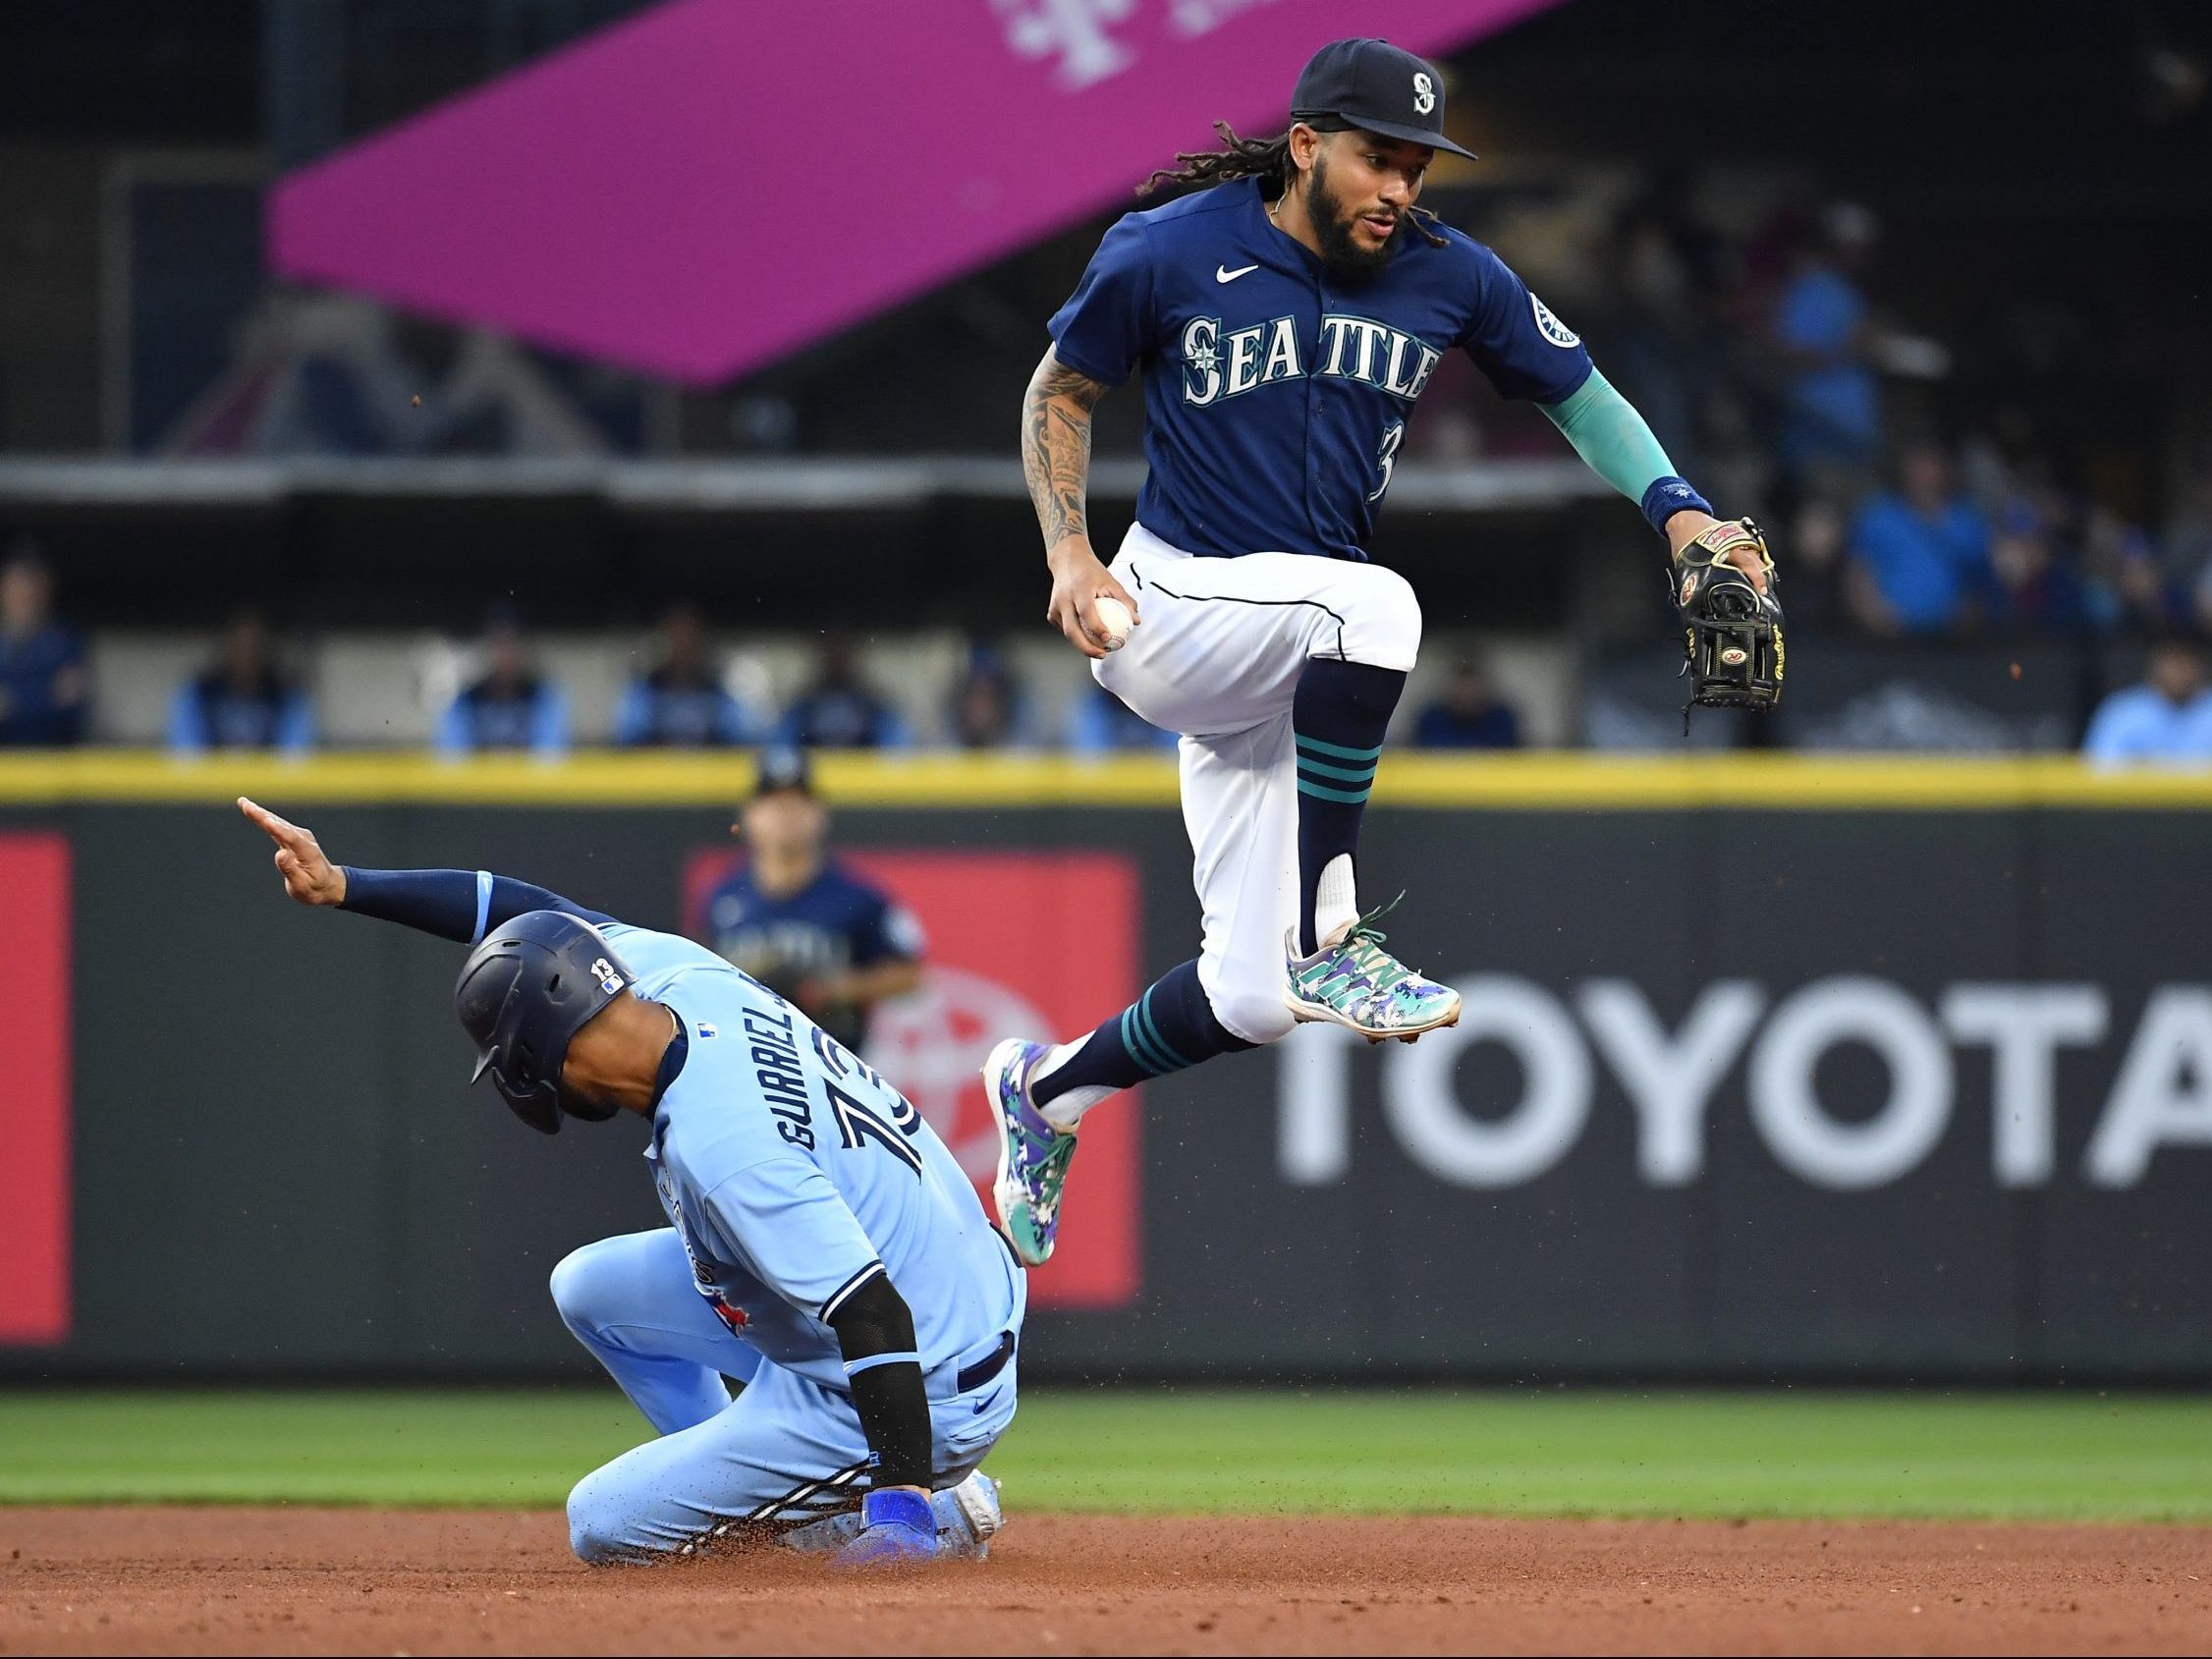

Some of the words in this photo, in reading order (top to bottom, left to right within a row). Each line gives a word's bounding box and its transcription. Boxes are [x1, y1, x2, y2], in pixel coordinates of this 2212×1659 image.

[1413, 73, 1436, 115] S
[1181, 314, 1443, 408] SEATTLE
[590, 958, 614, 981] 13
[742, 1007, 815, 1151] GURRIEL
[811, 1026, 921, 1187] 13
